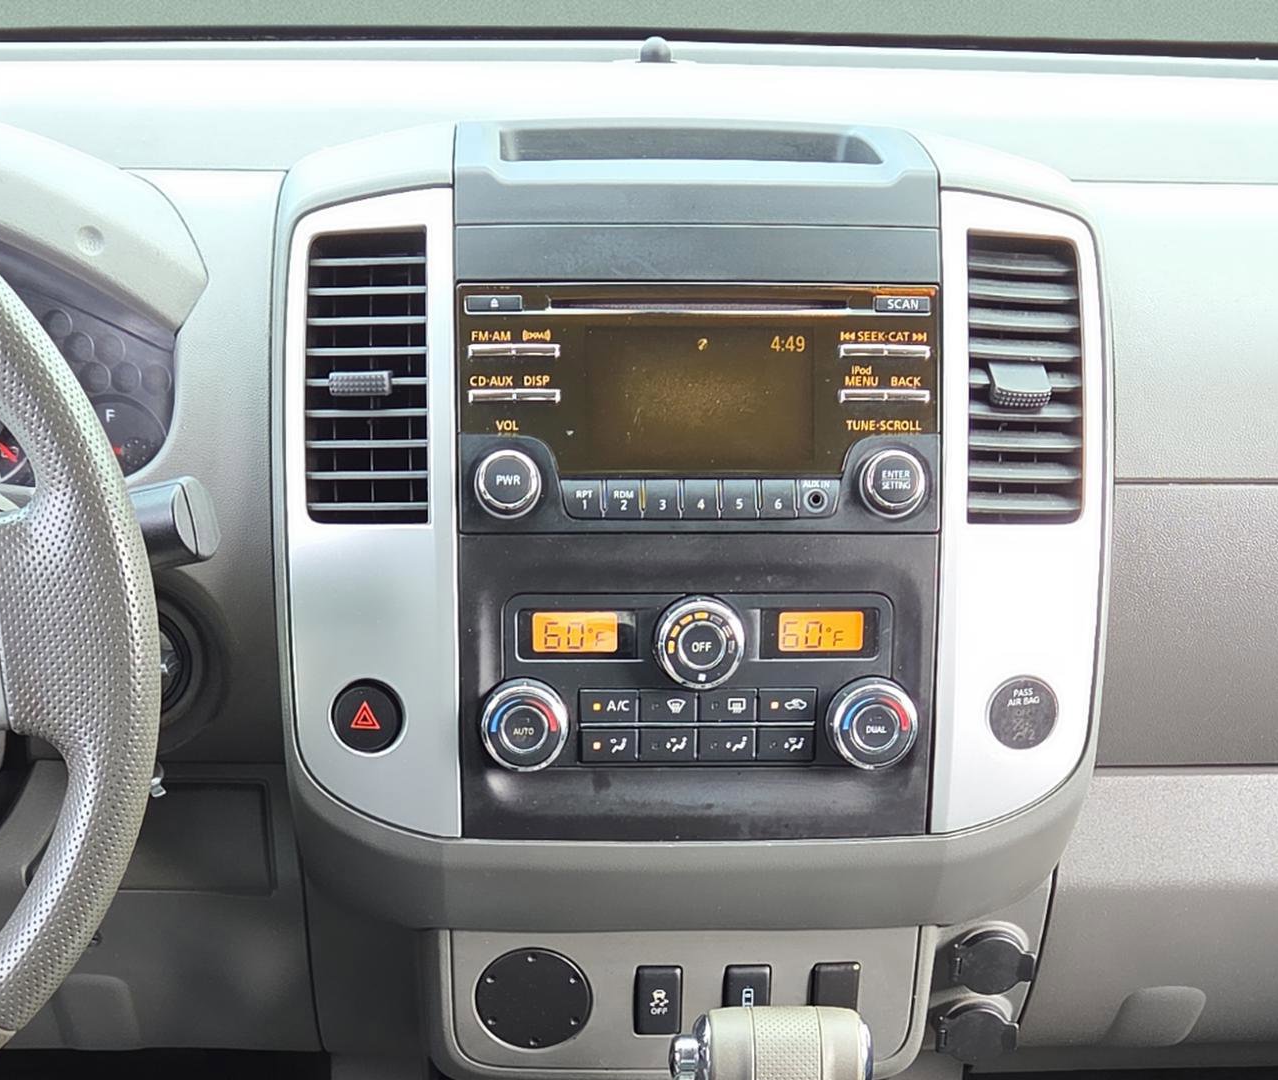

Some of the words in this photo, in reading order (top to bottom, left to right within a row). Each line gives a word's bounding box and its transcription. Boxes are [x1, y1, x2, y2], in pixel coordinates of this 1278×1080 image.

[887, 299, 919, 310] SCAN
[771, 335, 806, 352] 4:49
[851, 366, 872, 375] iPod
[523, 375, 550, 386] DISP
[844, 376, 879, 387] MENU
[890, 376, 921, 387] BACK
[106, 409, 115, 422] F
[496, 420, 519, 431] VOL
[881, 470, 910, 479] ENTER
[496, 475, 520, 486] PWR
[576, 490, 593, 499] RPT
[613, 490, 634, 499] RDM
[582, 500, 588, 509] 1
[621, 499, 628, 510] 2
[659, 499, 667, 510] 3
[697, 499, 705, 510] 4
[736, 499, 743, 510] 5
[774, 499, 782, 510] 6
[691, 641, 712, 652] OFF
[1013, 688, 1033, 697] PASS
[606, 700, 630, 712] A/C
[1007, 698, 1022, 707] AIR
[513, 727, 535, 736] AUTO
[865, 726, 887, 734] DUAL
[650, 1007, 668, 1016] OFF
